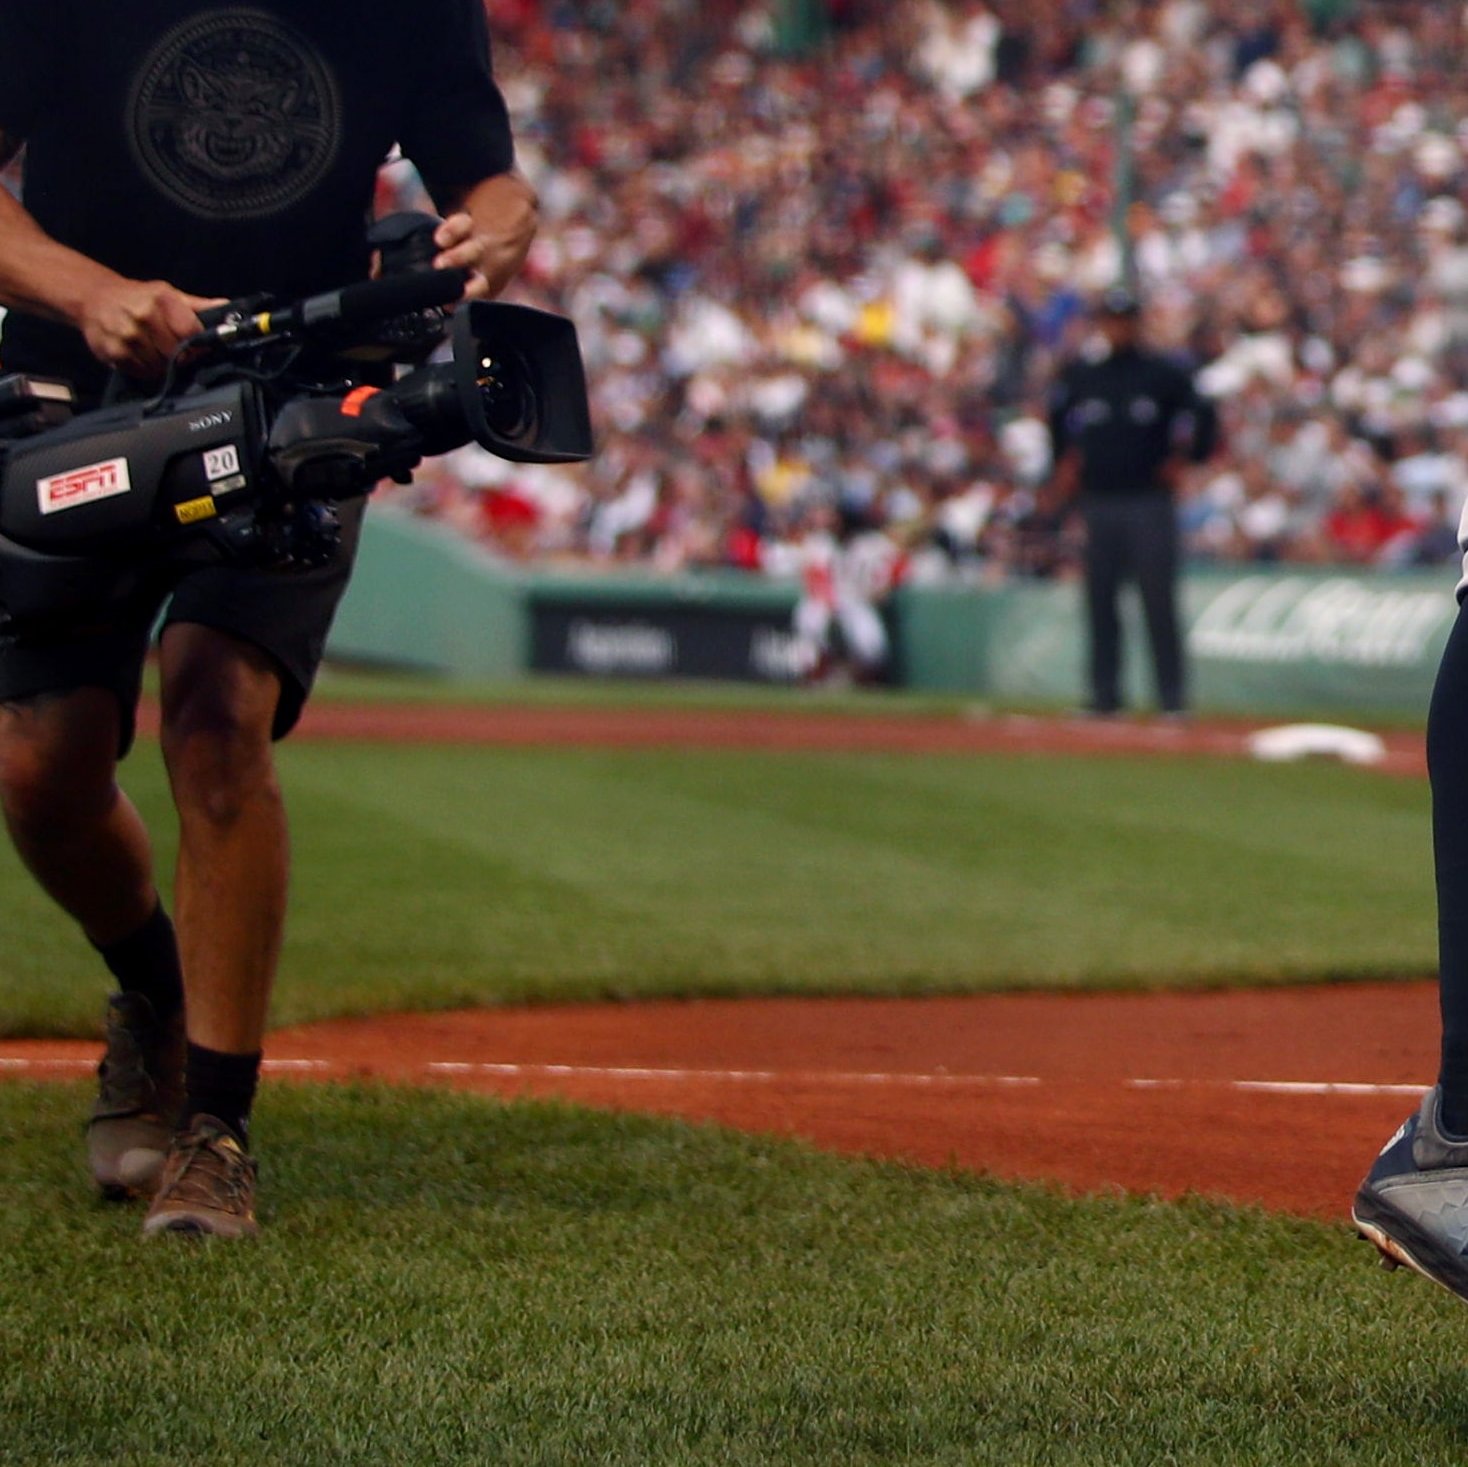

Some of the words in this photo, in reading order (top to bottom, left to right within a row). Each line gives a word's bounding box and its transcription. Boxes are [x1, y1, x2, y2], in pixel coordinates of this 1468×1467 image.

[188, 410, 233, 432] SONY
[208, 449, 235, 474] 20
[49, 463, 117, 501] ESPN
